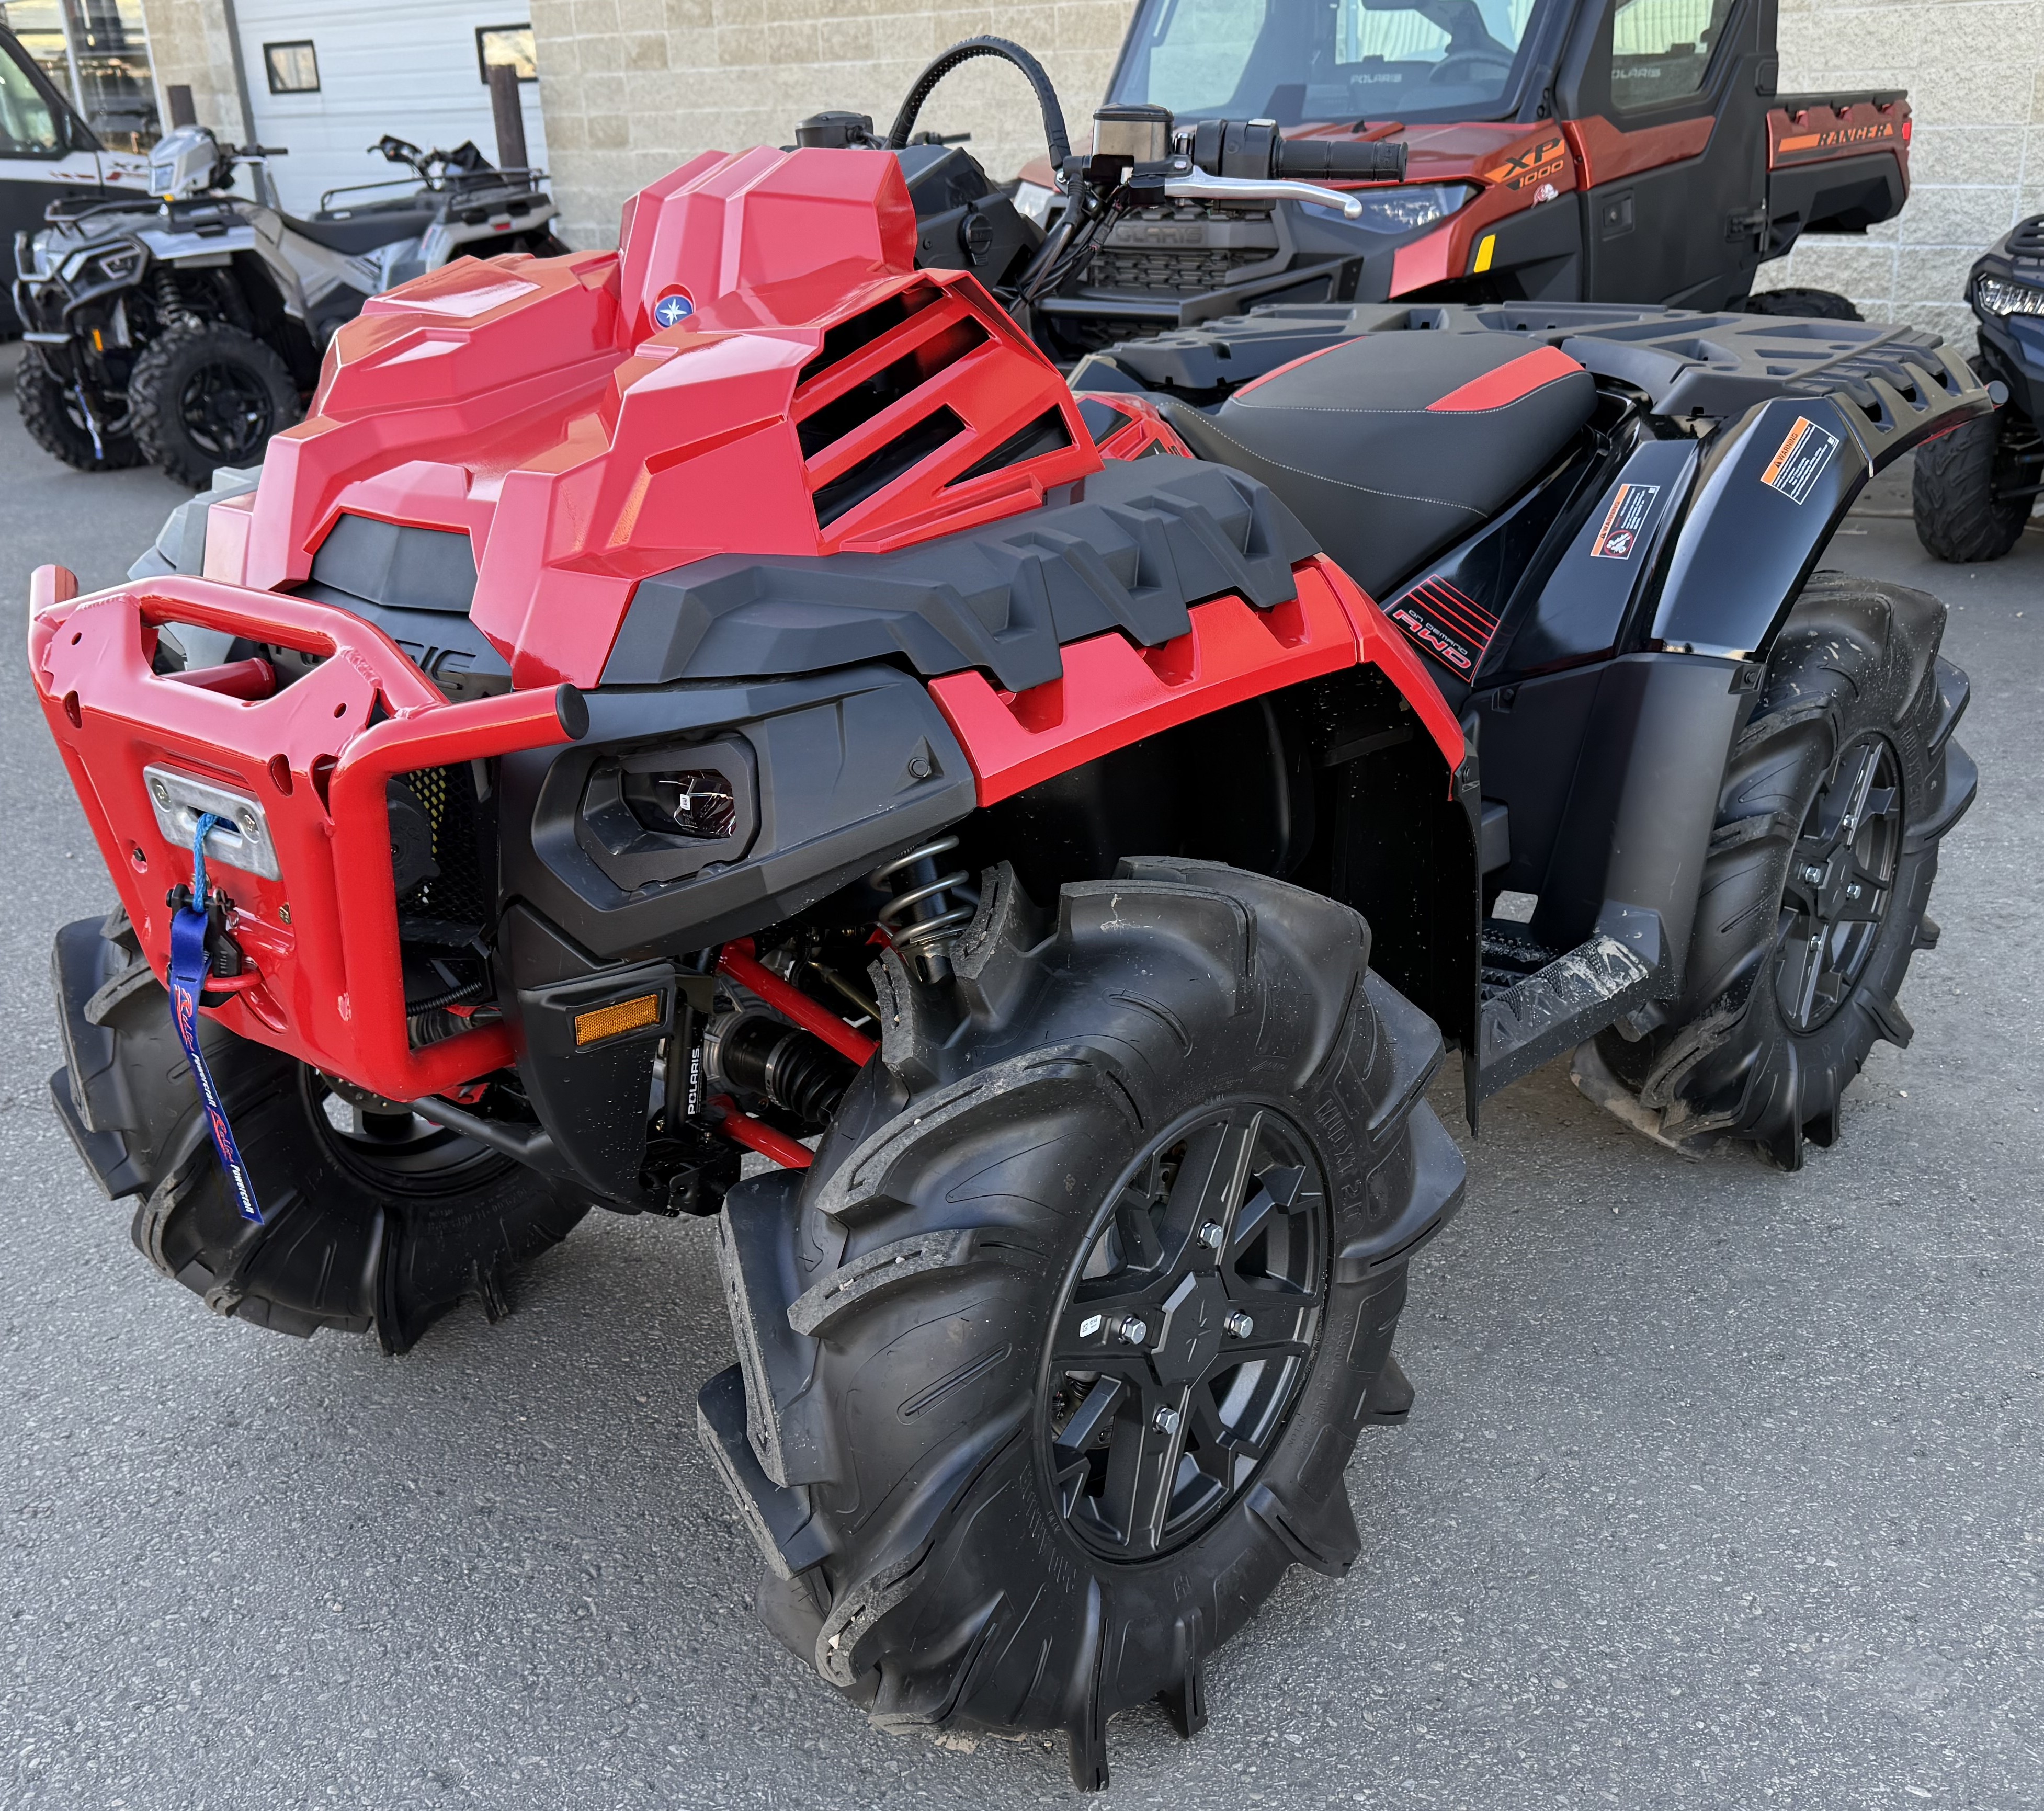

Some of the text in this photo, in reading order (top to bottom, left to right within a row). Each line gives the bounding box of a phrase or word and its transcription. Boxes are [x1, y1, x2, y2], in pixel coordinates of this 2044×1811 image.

[1611, 67, 1661, 79] OLARIS
[1819, 124, 1887, 146] RANGER
[1503, 138, 1561, 178] XP
[1519, 160, 1564, 188] 1000
[1778, 432, 1798, 461] WARNING
[1602, 501, 1620, 534] WARNING
[1392, 609, 1472, 669] AWD
[1409, 610, 1468, 655] ON DEMAND
[687, 1047, 700, 1115] POLARIS
